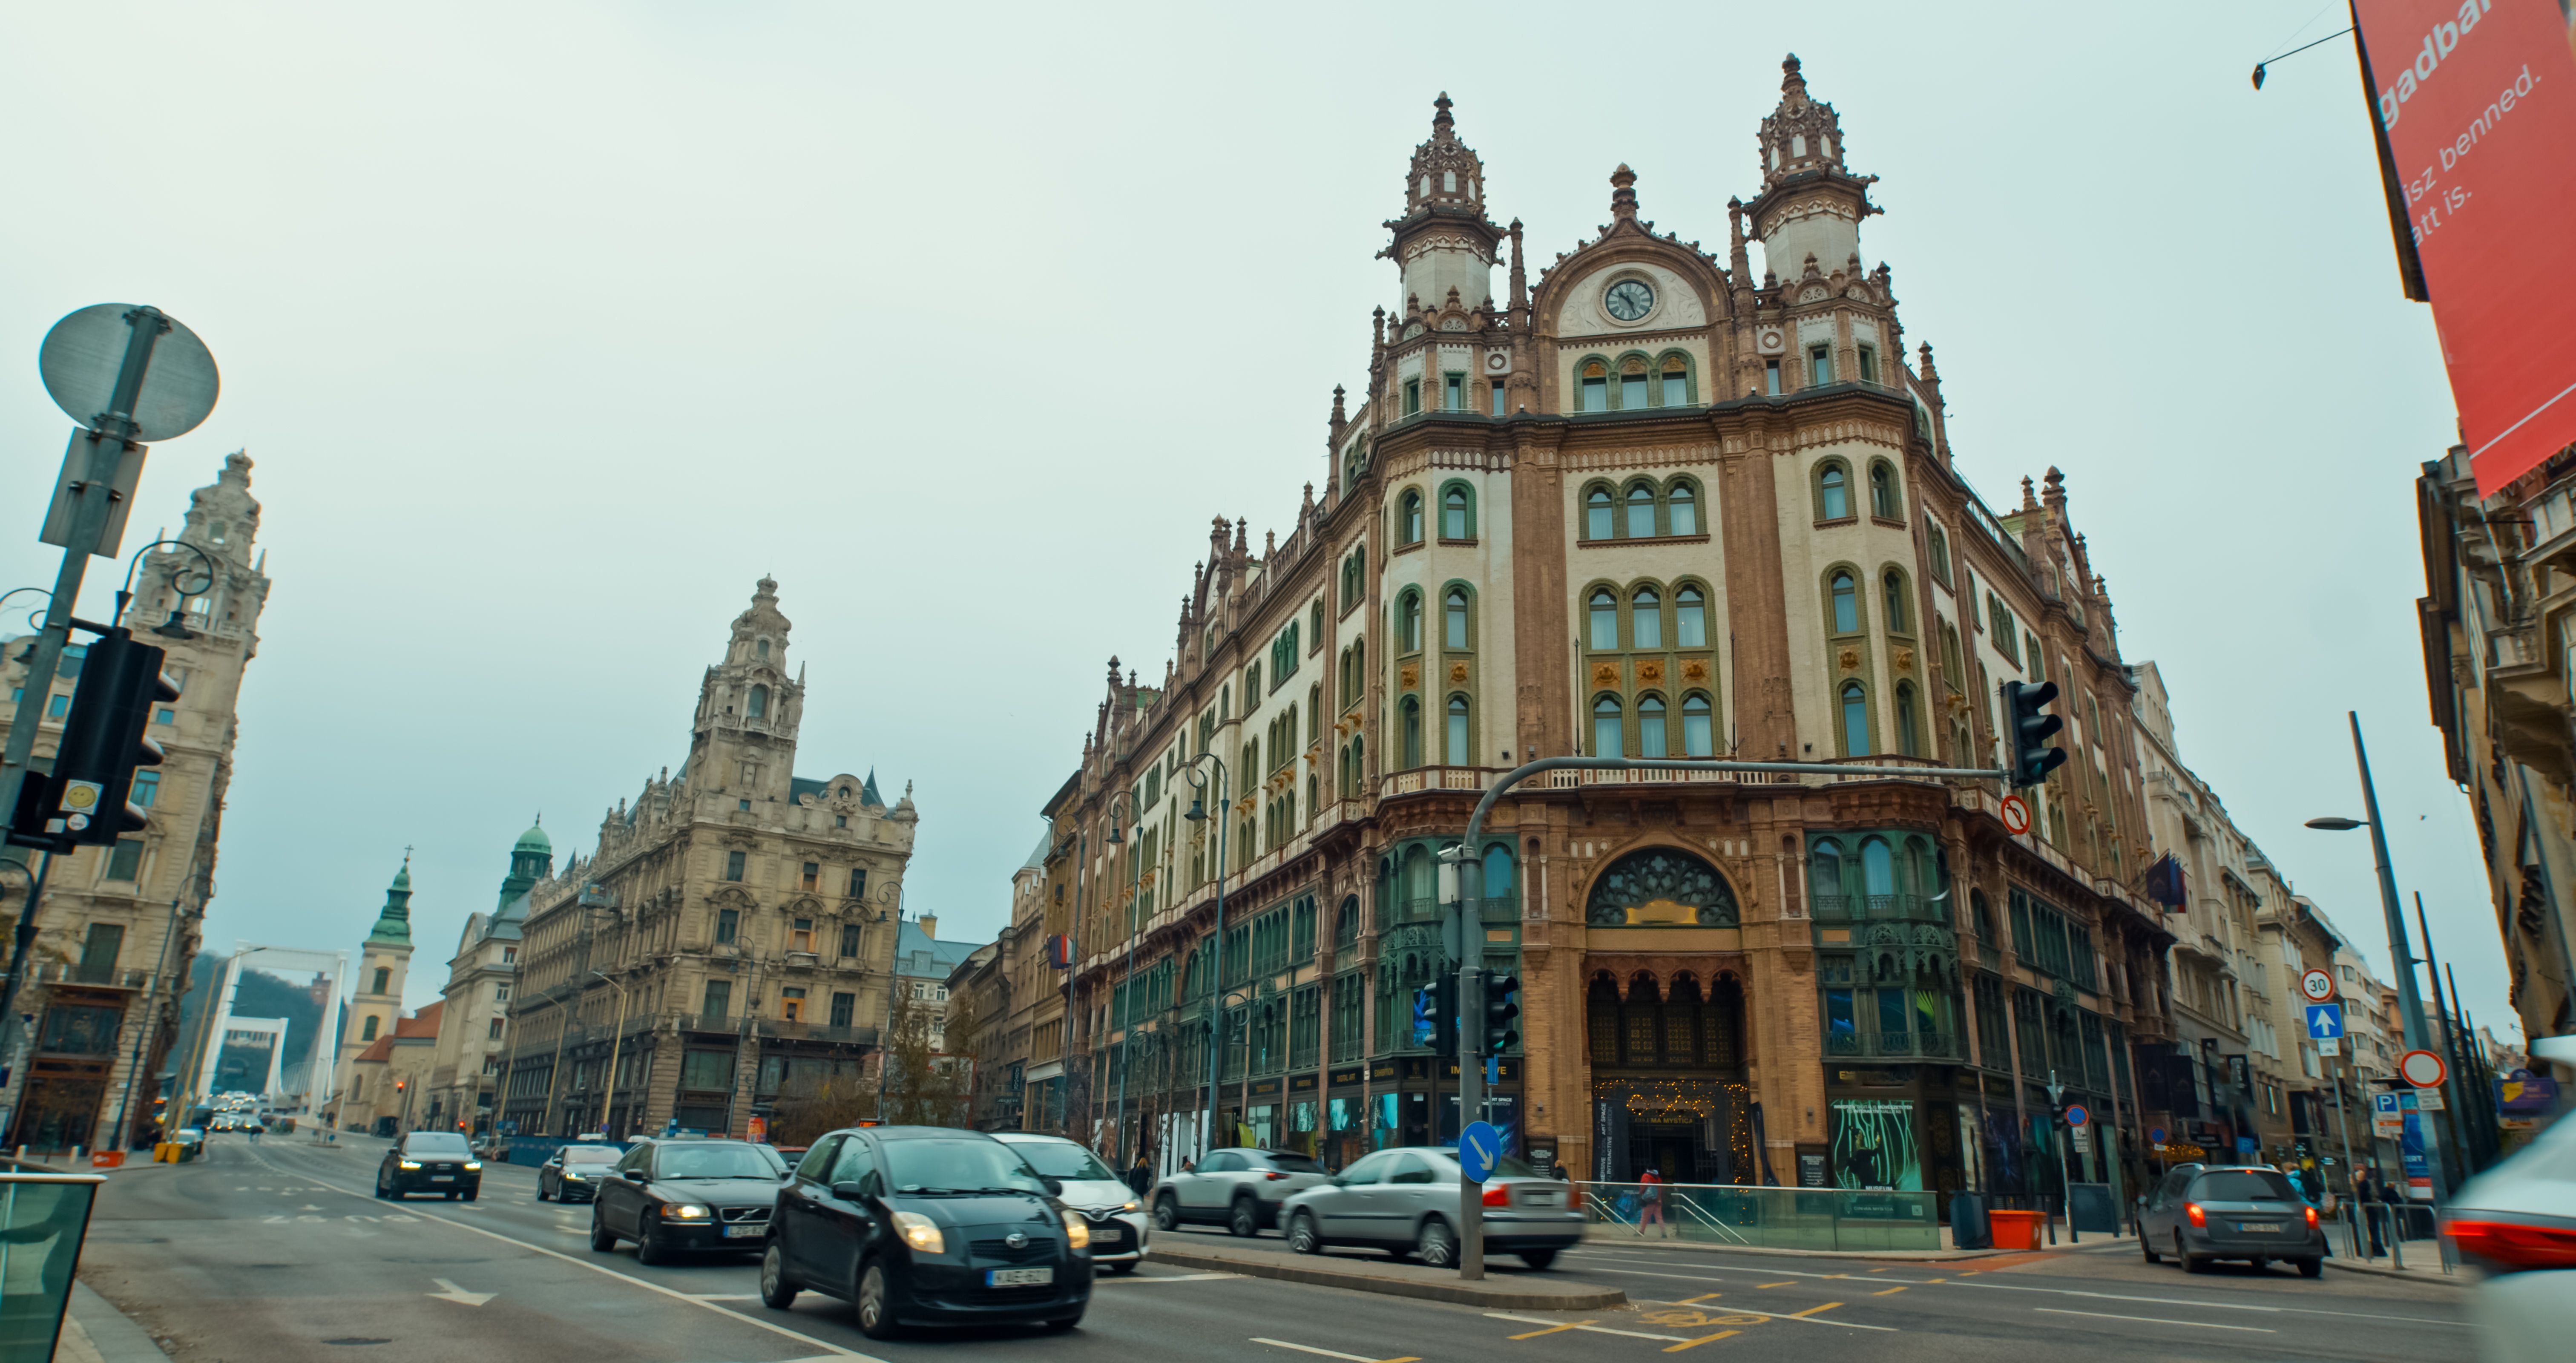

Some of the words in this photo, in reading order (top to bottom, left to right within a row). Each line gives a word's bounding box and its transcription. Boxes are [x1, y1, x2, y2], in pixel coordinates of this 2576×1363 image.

[2439, 64, 2542, 172] benned.
[2442, 186, 2472, 215] is.
[2309, 979, 2326, 992] 30
[2379, 1096, 2392, 1111] P
